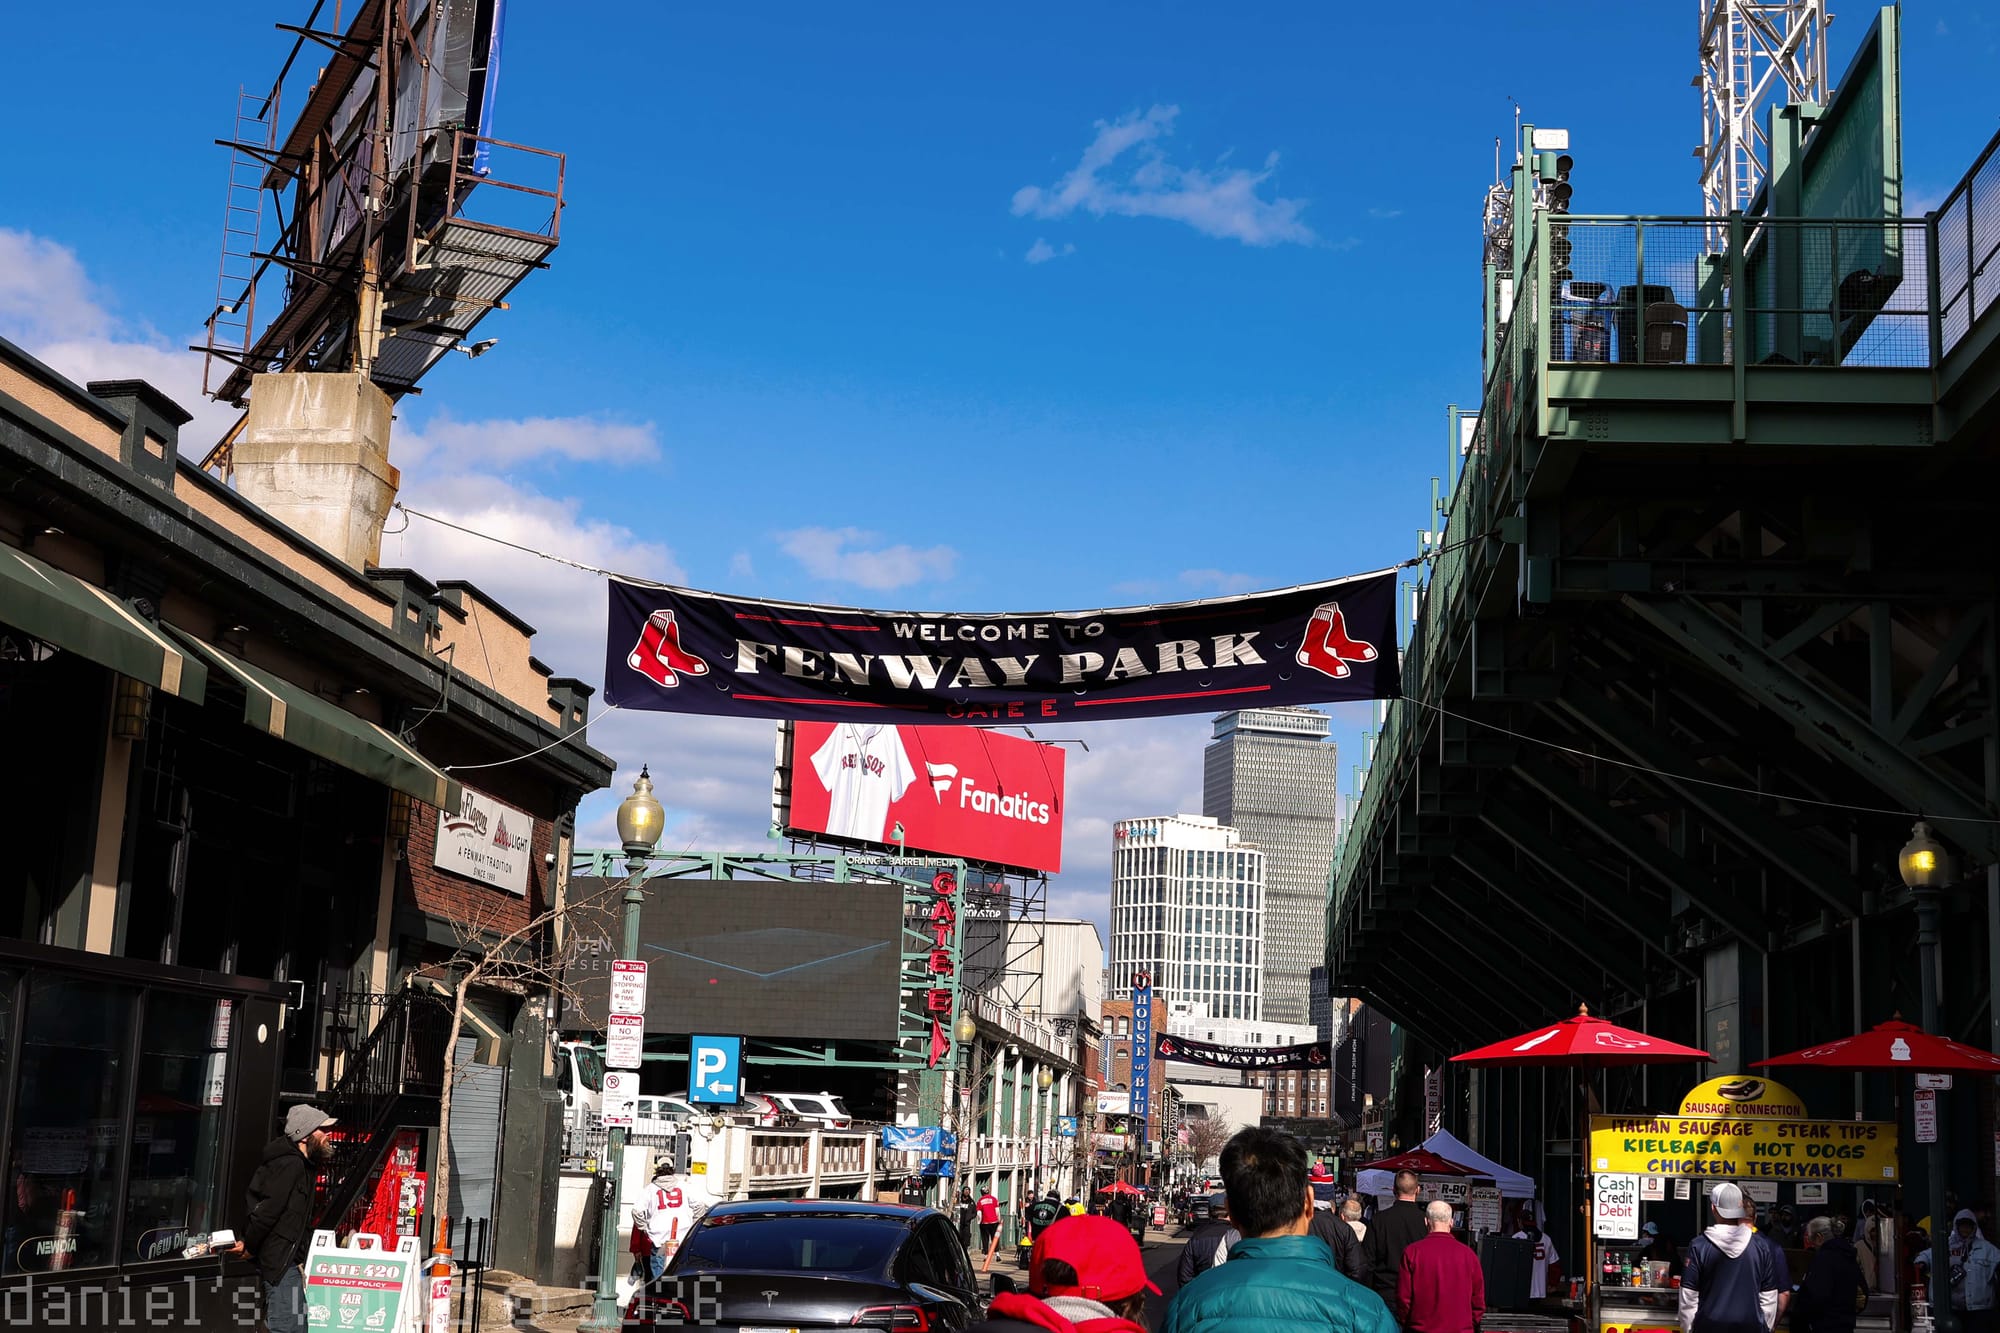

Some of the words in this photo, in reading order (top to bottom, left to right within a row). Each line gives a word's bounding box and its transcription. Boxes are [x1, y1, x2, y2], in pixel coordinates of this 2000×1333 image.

[893, 622, 1050, 641] WELCOME
[1064, 622, 1104, 639] TO
[734, 639, 1039, 689] FENWAY
[1059, 631, 1267, 684] PARK
[946, 702, 1024, 718] GATE
[1041, 699, 1058, 717] E
[865, 754, 885, 778] SOX
[960, 777, 1049, 825] Fanatics
[511, 835, 528, 853] LIGHT
[458, 846, 462, 856] A
[464, 848, 485, 864] FENWAY
[486, 856, 513, 874] TRADITION
[847, 856, 887, 865] ORANGE
[889, 857, 925, 866] BARREL
[928, 858, 958, 866] MEDIA
[930, 872, 957, 974] GATE
[928, 988, 953, 1015] E
[625, 1017, 642, 1025] ZONE
[1135, 995, 1147, 1057] HOUSE
[1183, 1047, 1251, 1064] FENWAY
[1255, 1053, 1301, 1066] PARK
[1428, 1079, 1438, 1097] BAR
[1685, 1103, 1730, 1114] SAUSAGE
[1735, 1104, 1800, 1116] CONNECTION
[1612, 1119, 1670, 1133] ITALIAN
[1679, 1120, 1753, 1136] SAUSAGE
[1777, 1123, 1830, 1139] STEAK
[1839, 1125, 1878, 1140] TIPS
[1623, 1139, 1722, 1154] KIELBASA
[1754, 1143, 1795, 1157] HOT
[1807, 1145, 1865, 1159] DOGS
[1647, 1159, 1736, 1174] CHICKEN
[1747, 1161, 1842, 1177] TERIYAKI
[1598, 1175, 1634, 1191] Cash
[656, 1188, 683, 1210] 19
[1599, 1190, 1633, 1204] Credit
[1600, 1203, 1632, 1217] Debit
[316, 1263, 361, 1276] GATE
[363, 1264, 400, 1278] 420
[323, 1278, 355, 1286] DUGOUT
[358, 1280, 387, 1288] POLICY
[340, 1293, 362, 1305] FAIR
